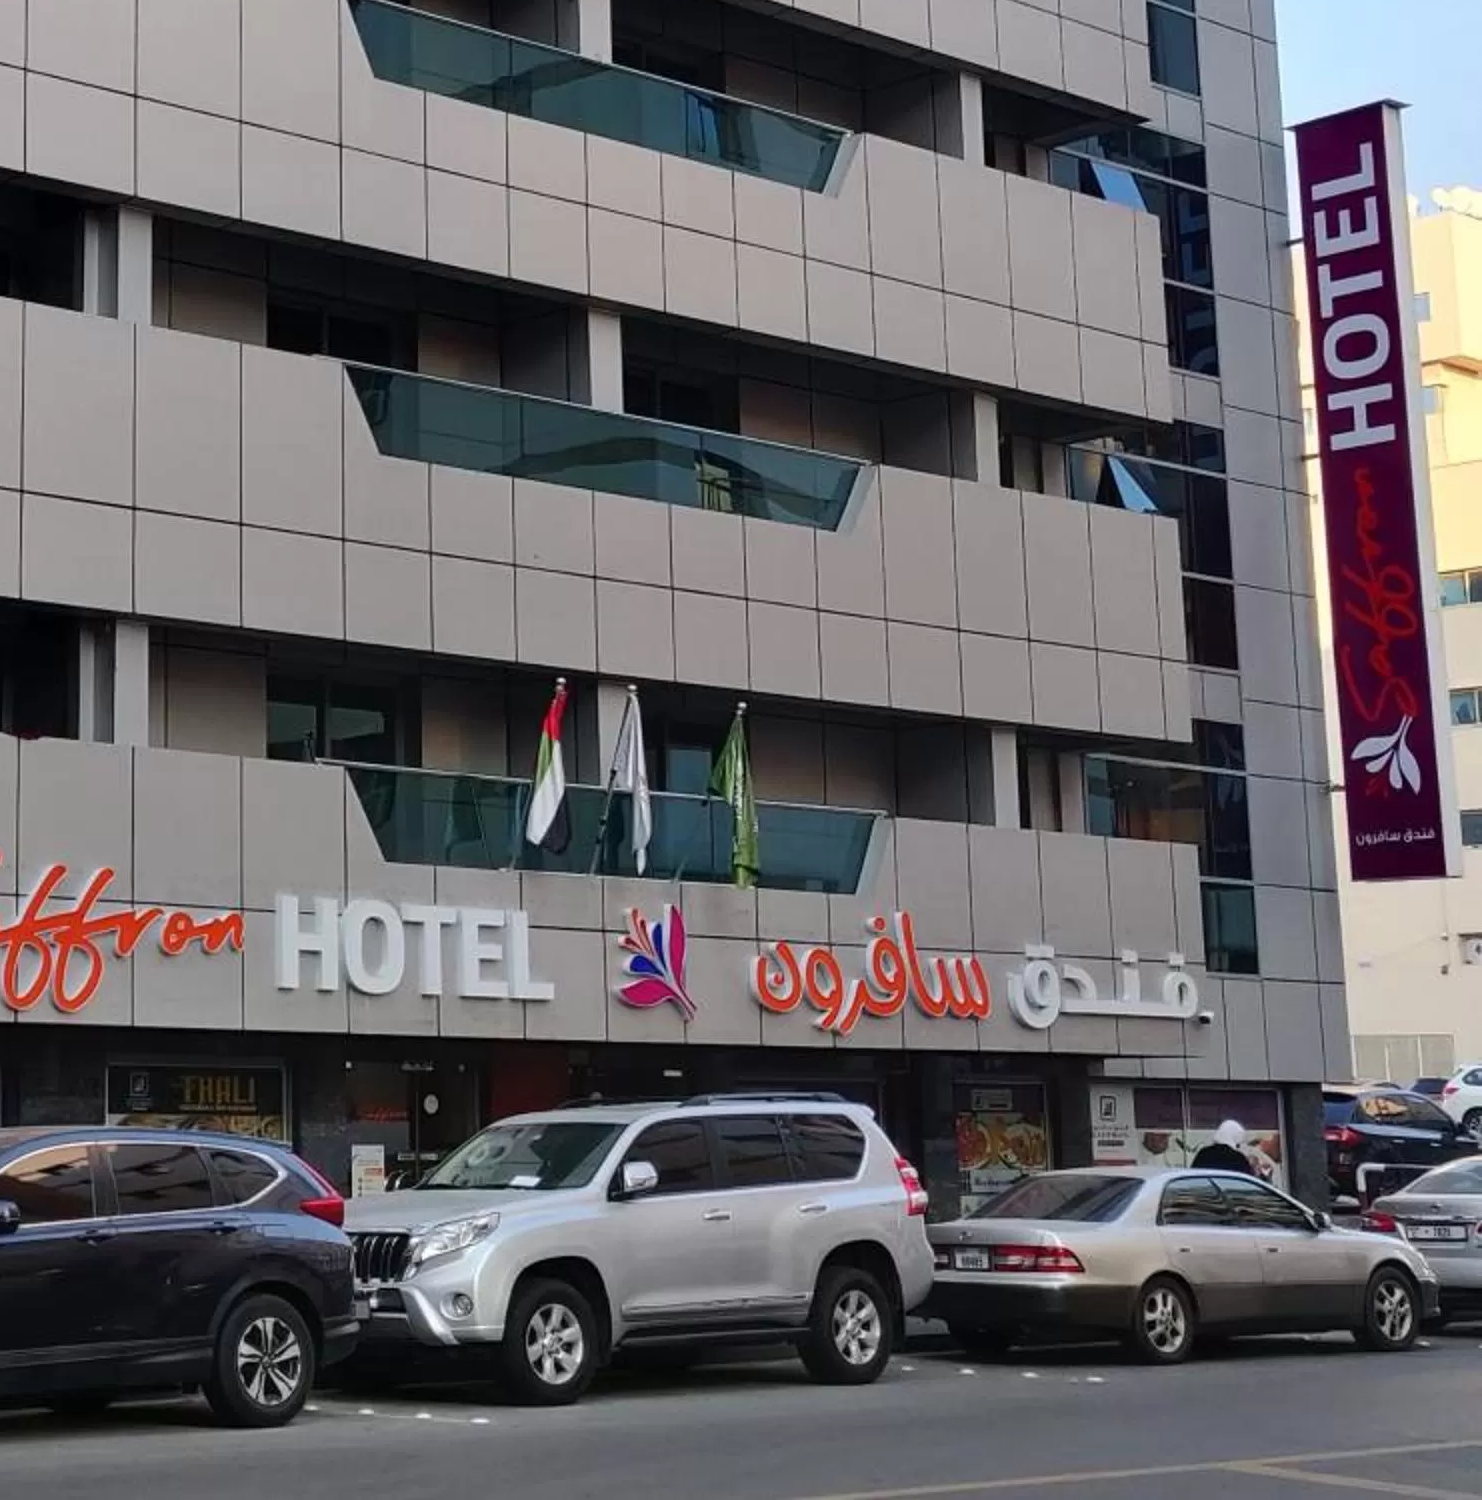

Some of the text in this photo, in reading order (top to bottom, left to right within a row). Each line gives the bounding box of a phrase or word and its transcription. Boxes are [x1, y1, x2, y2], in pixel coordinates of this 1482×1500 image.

[1311, 141, 1396, 451] HOTEL
[1342, 468, 1422, 722] Saffron
[1355, 826, 1436, 847] فندق سافرون
[275, 892, 555, 1001] HOTEL
[750, 908, 1198, 1037] فندق سافرون
